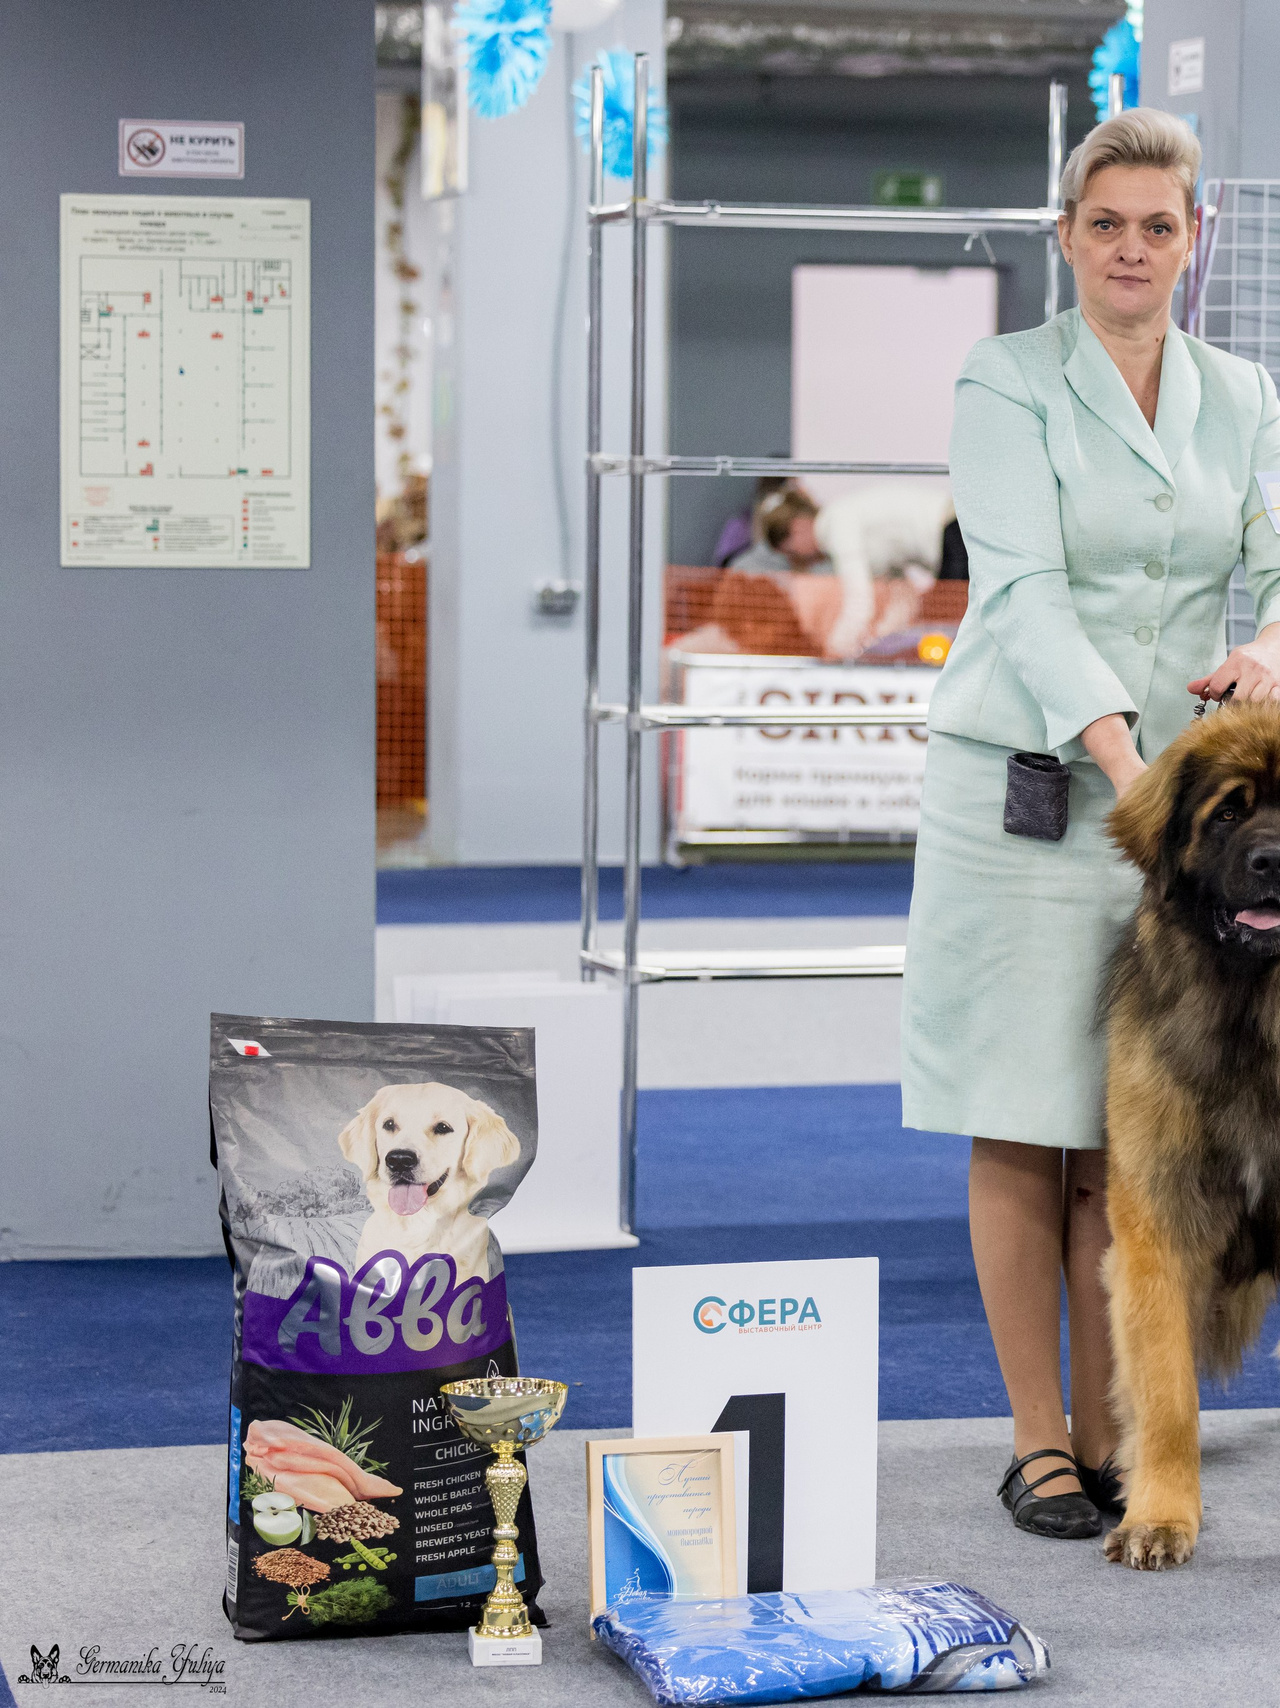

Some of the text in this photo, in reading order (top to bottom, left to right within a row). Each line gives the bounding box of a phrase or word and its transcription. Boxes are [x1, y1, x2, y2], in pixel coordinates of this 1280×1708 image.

[693, 1296, 822, 1334] СФЕРА
[738, 1324, 796, 1334] ВЫСТАВОЧНЫЙ
[435, 1442, 481, 1460] CHICKE
[414, 1471, 481, 1490] FRESH CHICKEN
[414, 1485, 482, 1504] WHOLE BARLEY
[710, 1392, 786, 1595] 1
[415, 1502, 473, 1519] WHOLE PEAS
[415, 1521, 454, 1534] LINSEED
[416, 1527, 491, 1549] BREWER'S YEAST
[416, 1546, 476, 1563] FRESH APPLE
[436, 1572, 481, 1589] ADULT
